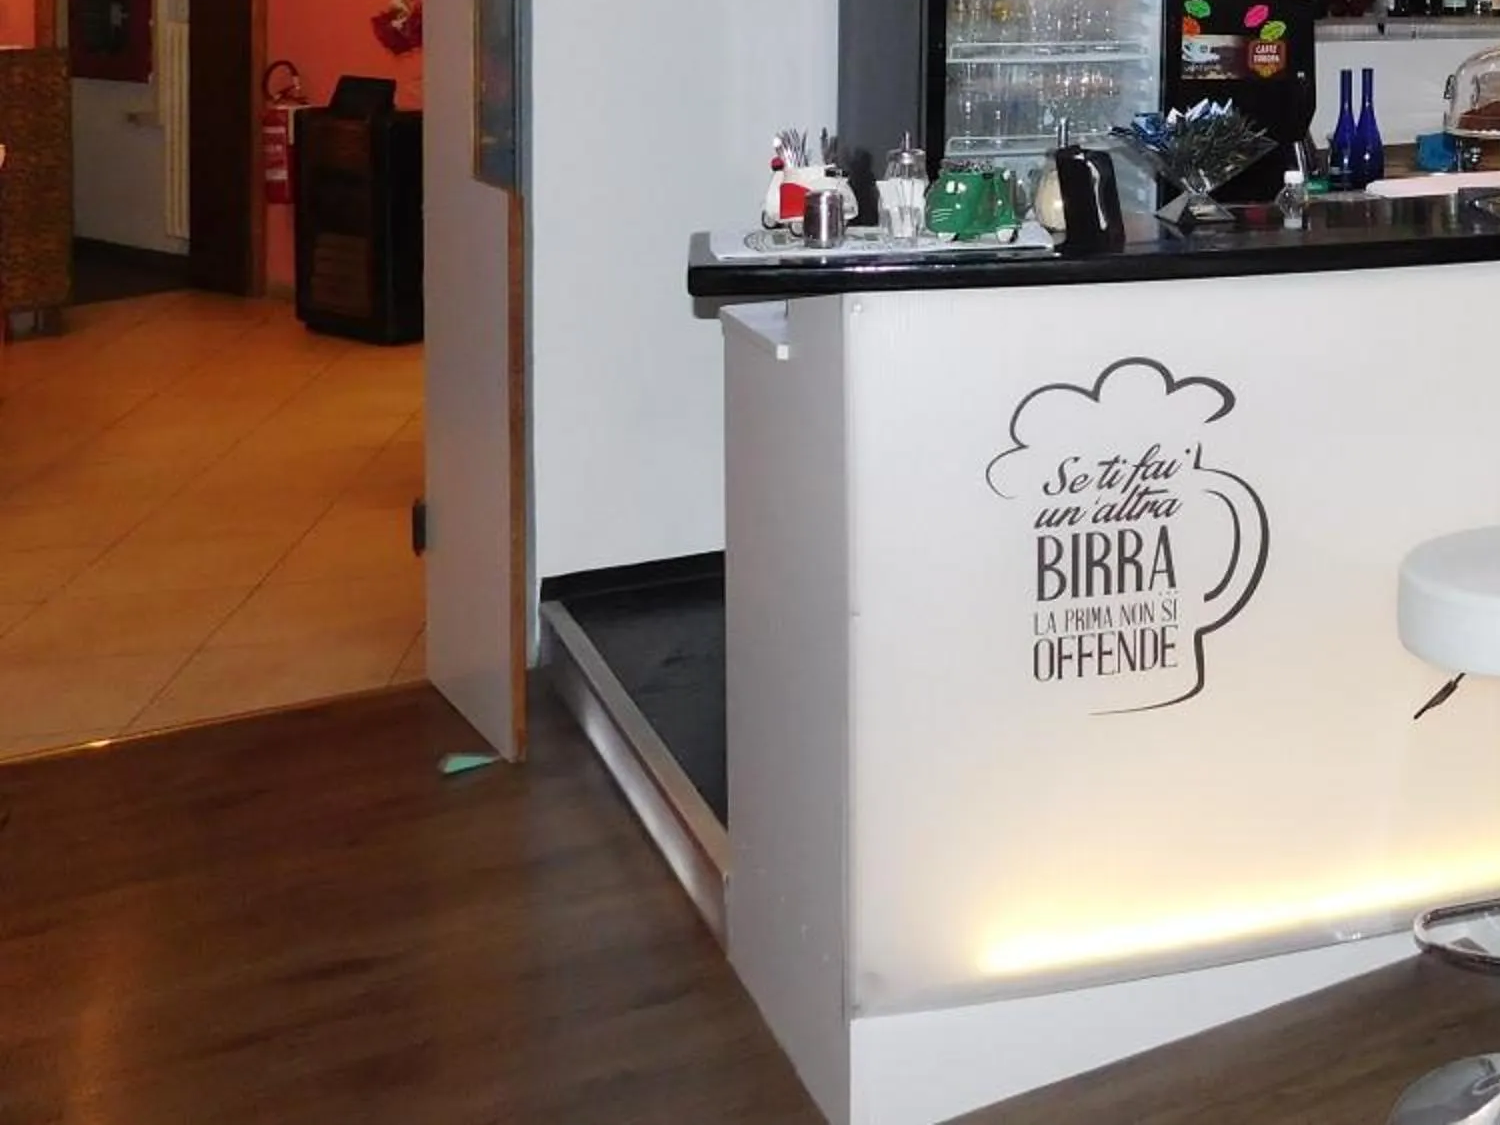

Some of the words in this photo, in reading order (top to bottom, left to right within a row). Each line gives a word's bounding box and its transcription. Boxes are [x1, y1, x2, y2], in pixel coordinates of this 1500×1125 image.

[1043, 456, 1093, 497] Se
[1095, 455, 1127, 493] ti
[1121, 443, 1192, 495] fai
[1033, 610, 1057, 637] LA
[1064, 605, 1114, 633] PRIMA
[1119, 600, 1155, 626] NON
[1161, 598, 1178, 622] SI
[1033, 625, 1179, 683] OFFENDE
